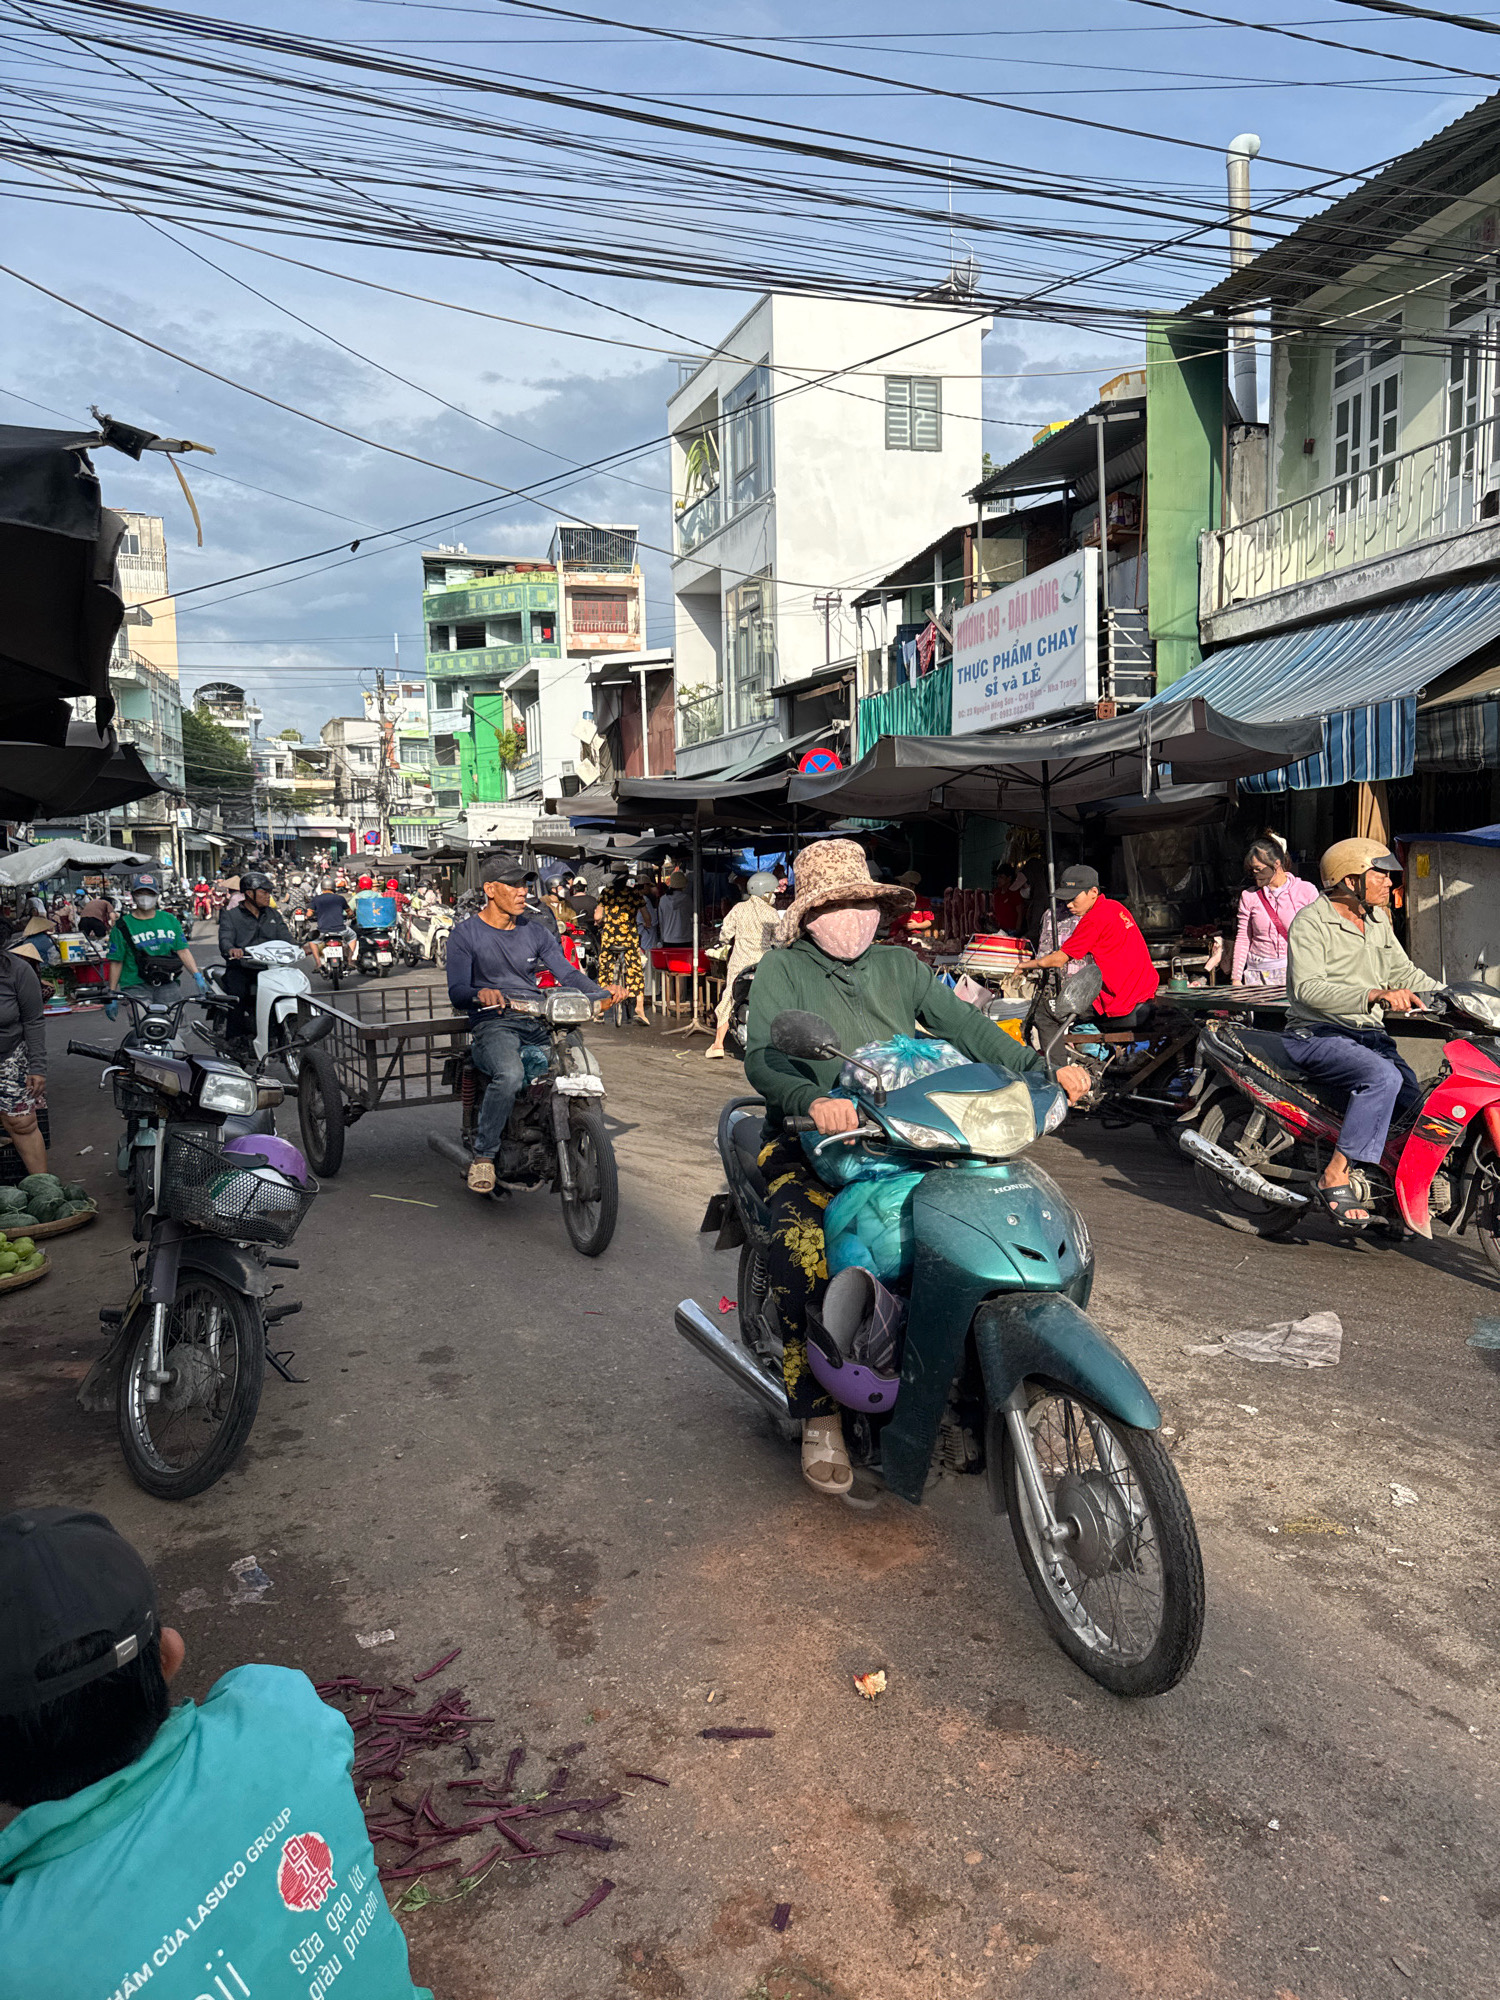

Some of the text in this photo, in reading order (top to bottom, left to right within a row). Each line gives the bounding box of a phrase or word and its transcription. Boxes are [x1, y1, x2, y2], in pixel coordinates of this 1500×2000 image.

[987, 605, 1000, 640] 99
[1030, 578, 1059, 622] NÓNG
[957, 624, 1079, 685] THỰC PHẨM CHAY
[1001, 675, 1018, 693] và
[1022, 662, 1042, 687] LẺ
[1047, 683, 1059, 694] Nha
[1059, 678, 1077, 690] Trang
[993, 1183, 1033, 1194] HONDA
[152, 1928, 190, 1967] CỦA
[186, 1860, 247, 1932] LASUCO
[246, 1806, 293, 1863] GROUP
[289, 1931, 325, 1975] Sữa
[326, 1892, 353, 1936] gạo
[308, 1890, 379, 2000] giàu protein
